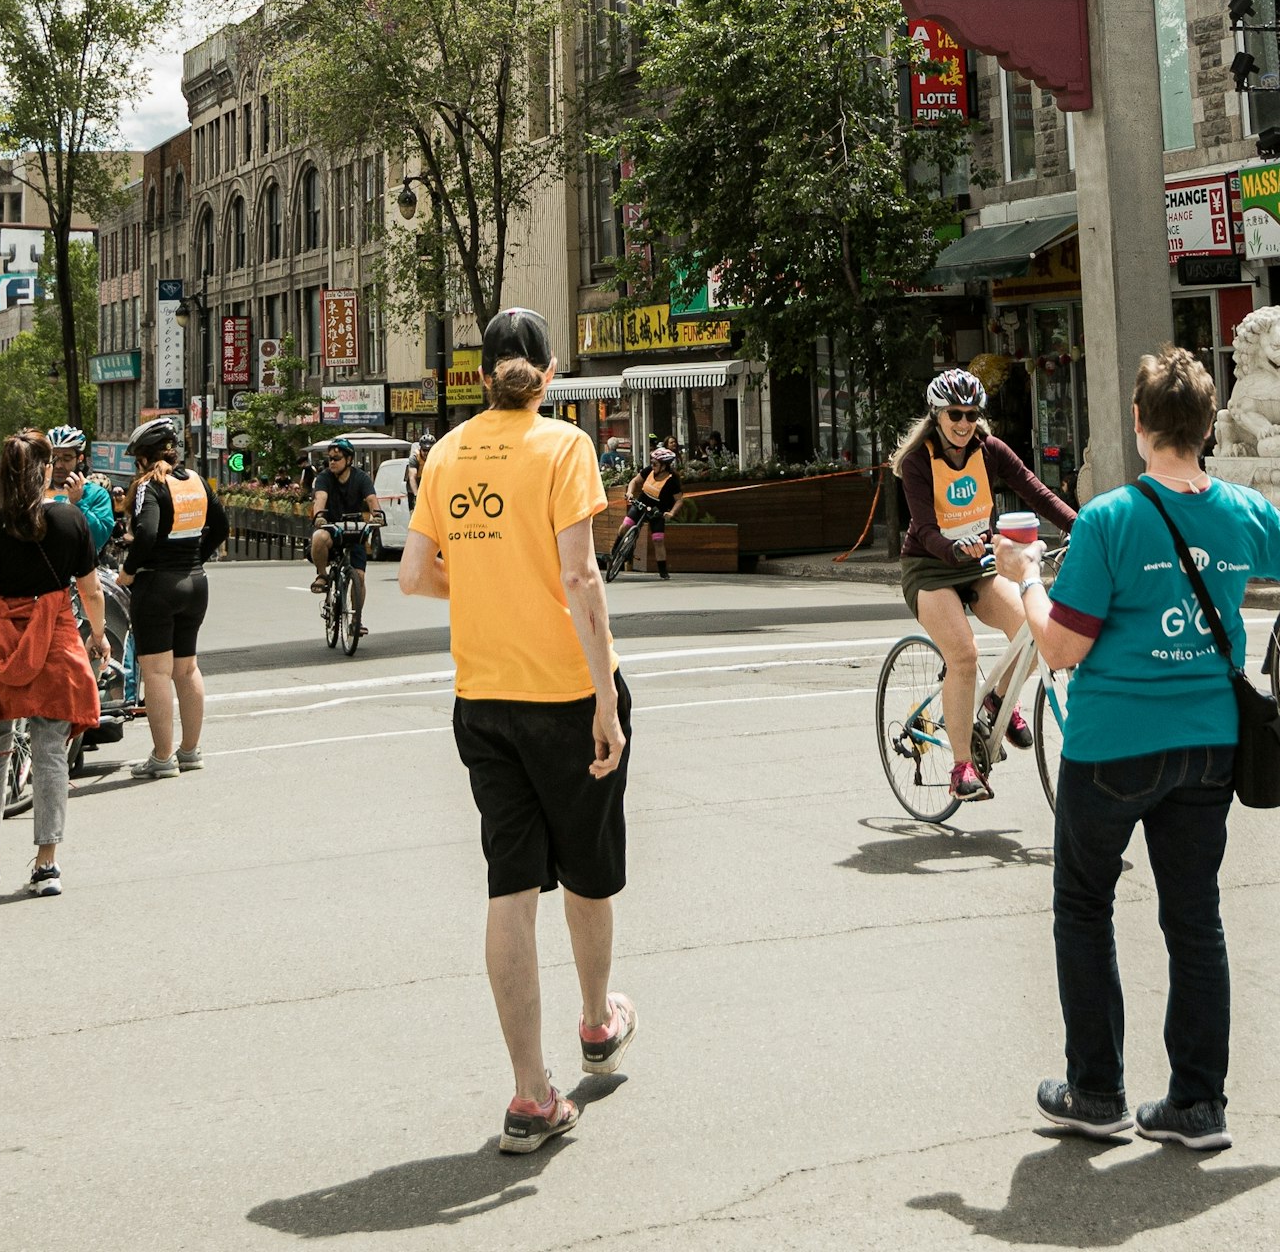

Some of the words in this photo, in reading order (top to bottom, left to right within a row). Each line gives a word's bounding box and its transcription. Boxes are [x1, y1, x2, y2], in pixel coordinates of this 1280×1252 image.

[920, 89, 957, 105] LOTTÉ
[917, 109, 963, 121] FURA
[1166, 211, 1193, 223] HANGE
[344, 300, 354, 356] MASSAGE
[445, 371, 480, 386] UNAN
[951, 481, 977, 499] lait
[449, 532, 461, 540] GO
[464, 529, 485, 539] VÉLO
[1151, 649, 1168, 659] GO
[1170, 648, 1193, 661] VÉLO
